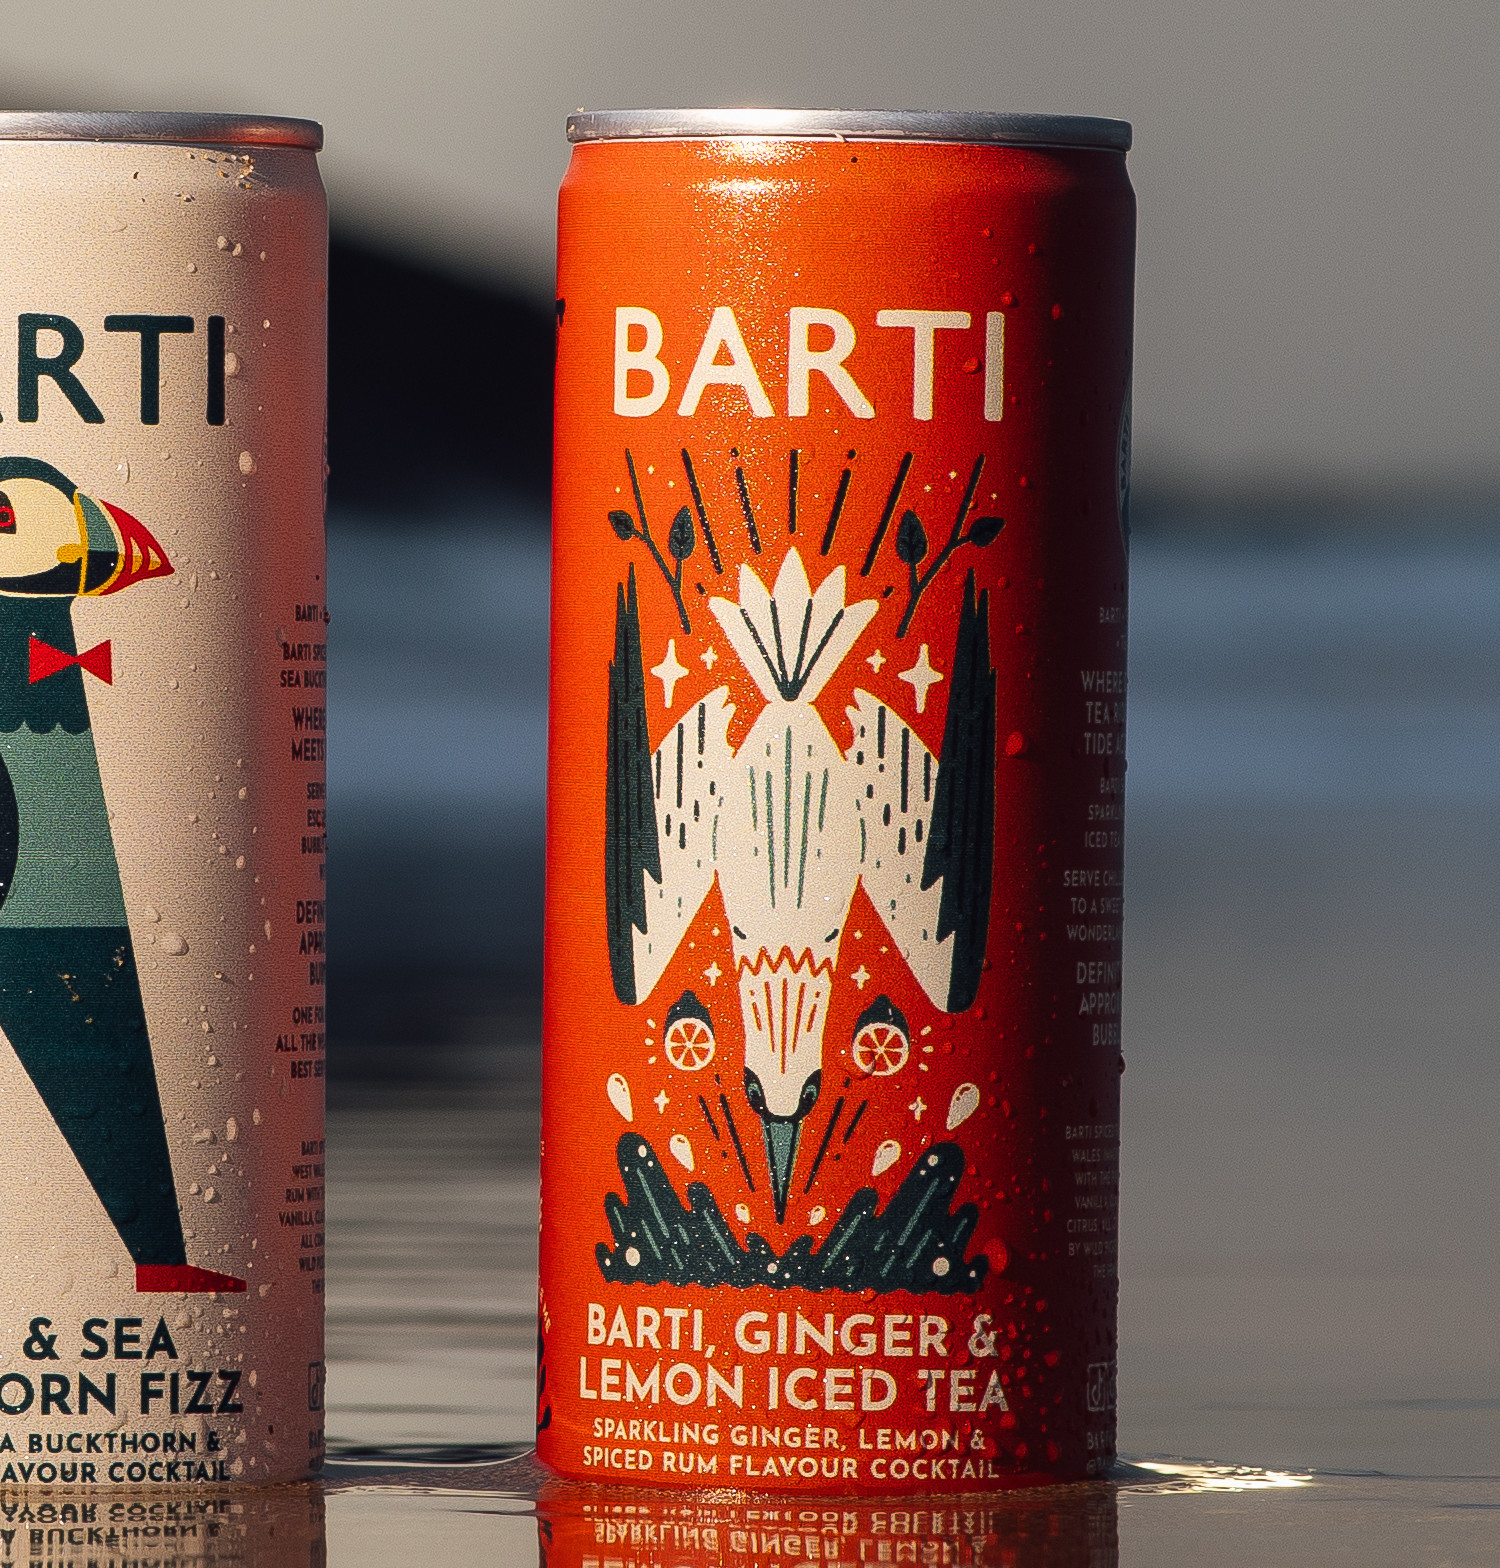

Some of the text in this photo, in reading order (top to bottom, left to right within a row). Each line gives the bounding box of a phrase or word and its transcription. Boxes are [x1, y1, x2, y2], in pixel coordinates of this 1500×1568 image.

[613, 306, 1005, 421] BARTI
[282, 642, 311, 661] BARTI
[280, 669, 301, 688] SEA
[1085, 701, 1110, 724] TEA
[1083, 732, 1113, 755] TIDE
[1084, 831, 1108, 849] ICED
[1063, 869, 1101, 887] SERVE
[1070, 897, 1087, 914] TO
[1090, 898, 1098, 914] A
[292, 1006, 313, 1025] ONE
[275, 1033, 298, 1053] ALL
[300, 1033, 317, 1052] THE
[291, 1060, 312, 1079] BEST
[23, 1316, 60, 1361] &
[80, 1315, 179, 1360] SEA
[587, 1302, 1000, 1359] BARTI, GINGER &
[141, 1369, 244, 1416] FIZZ
[578, 1355, 1010, 1413] LEMON ICED TEA
[28, 1432, 197, 1454] BUCKTHORN
[206, 1430, 222, 1453] &
[592, 1417, 987, 1452] SPARKLING GINGER, LEMON &
[108, 1459, 232, 1483] COCKTAIL
[582, 1445, 1000, 1481] SPICED RUM FLAVOUR COCKTAIL
